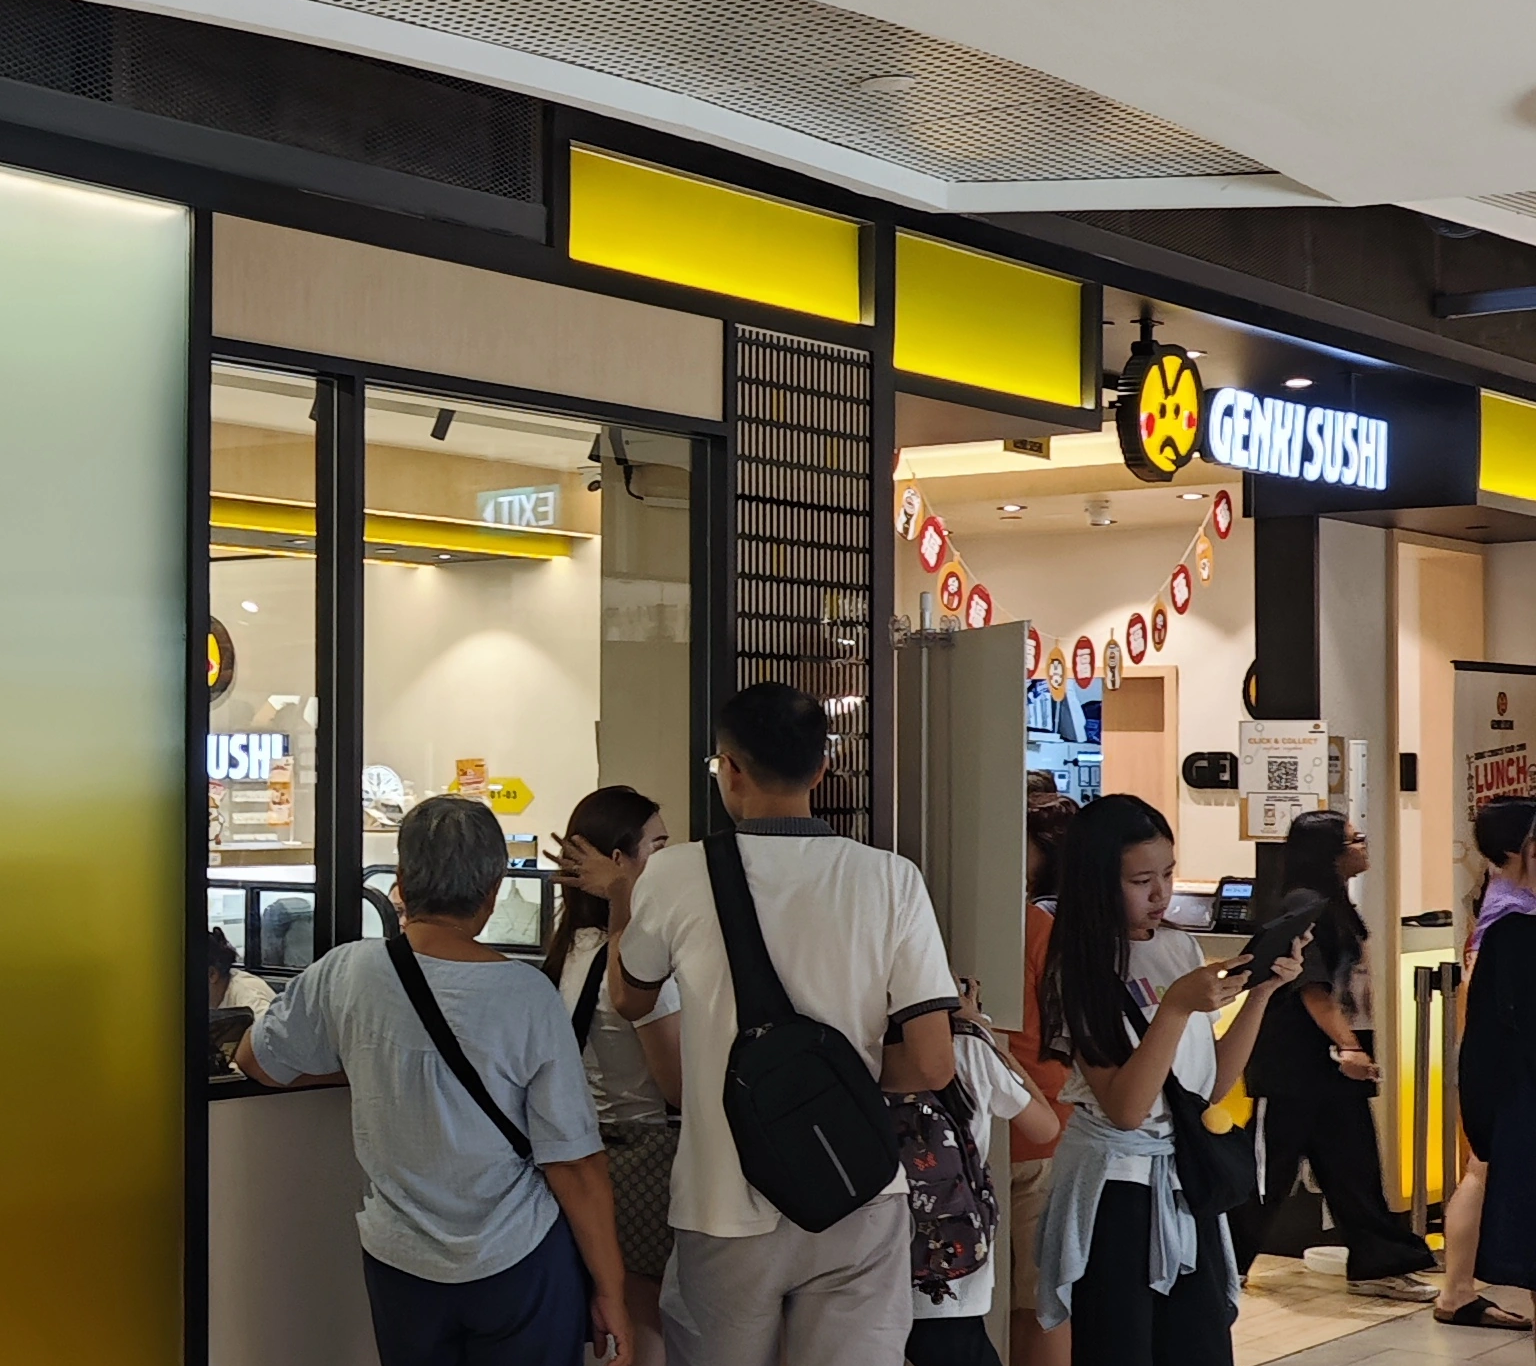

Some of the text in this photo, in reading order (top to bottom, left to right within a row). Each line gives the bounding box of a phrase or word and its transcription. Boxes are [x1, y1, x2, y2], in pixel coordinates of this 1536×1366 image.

[1209, 387, 1388, 490] GENKI SUSHI
[1475, 754, 1528, 795] LUNCH
